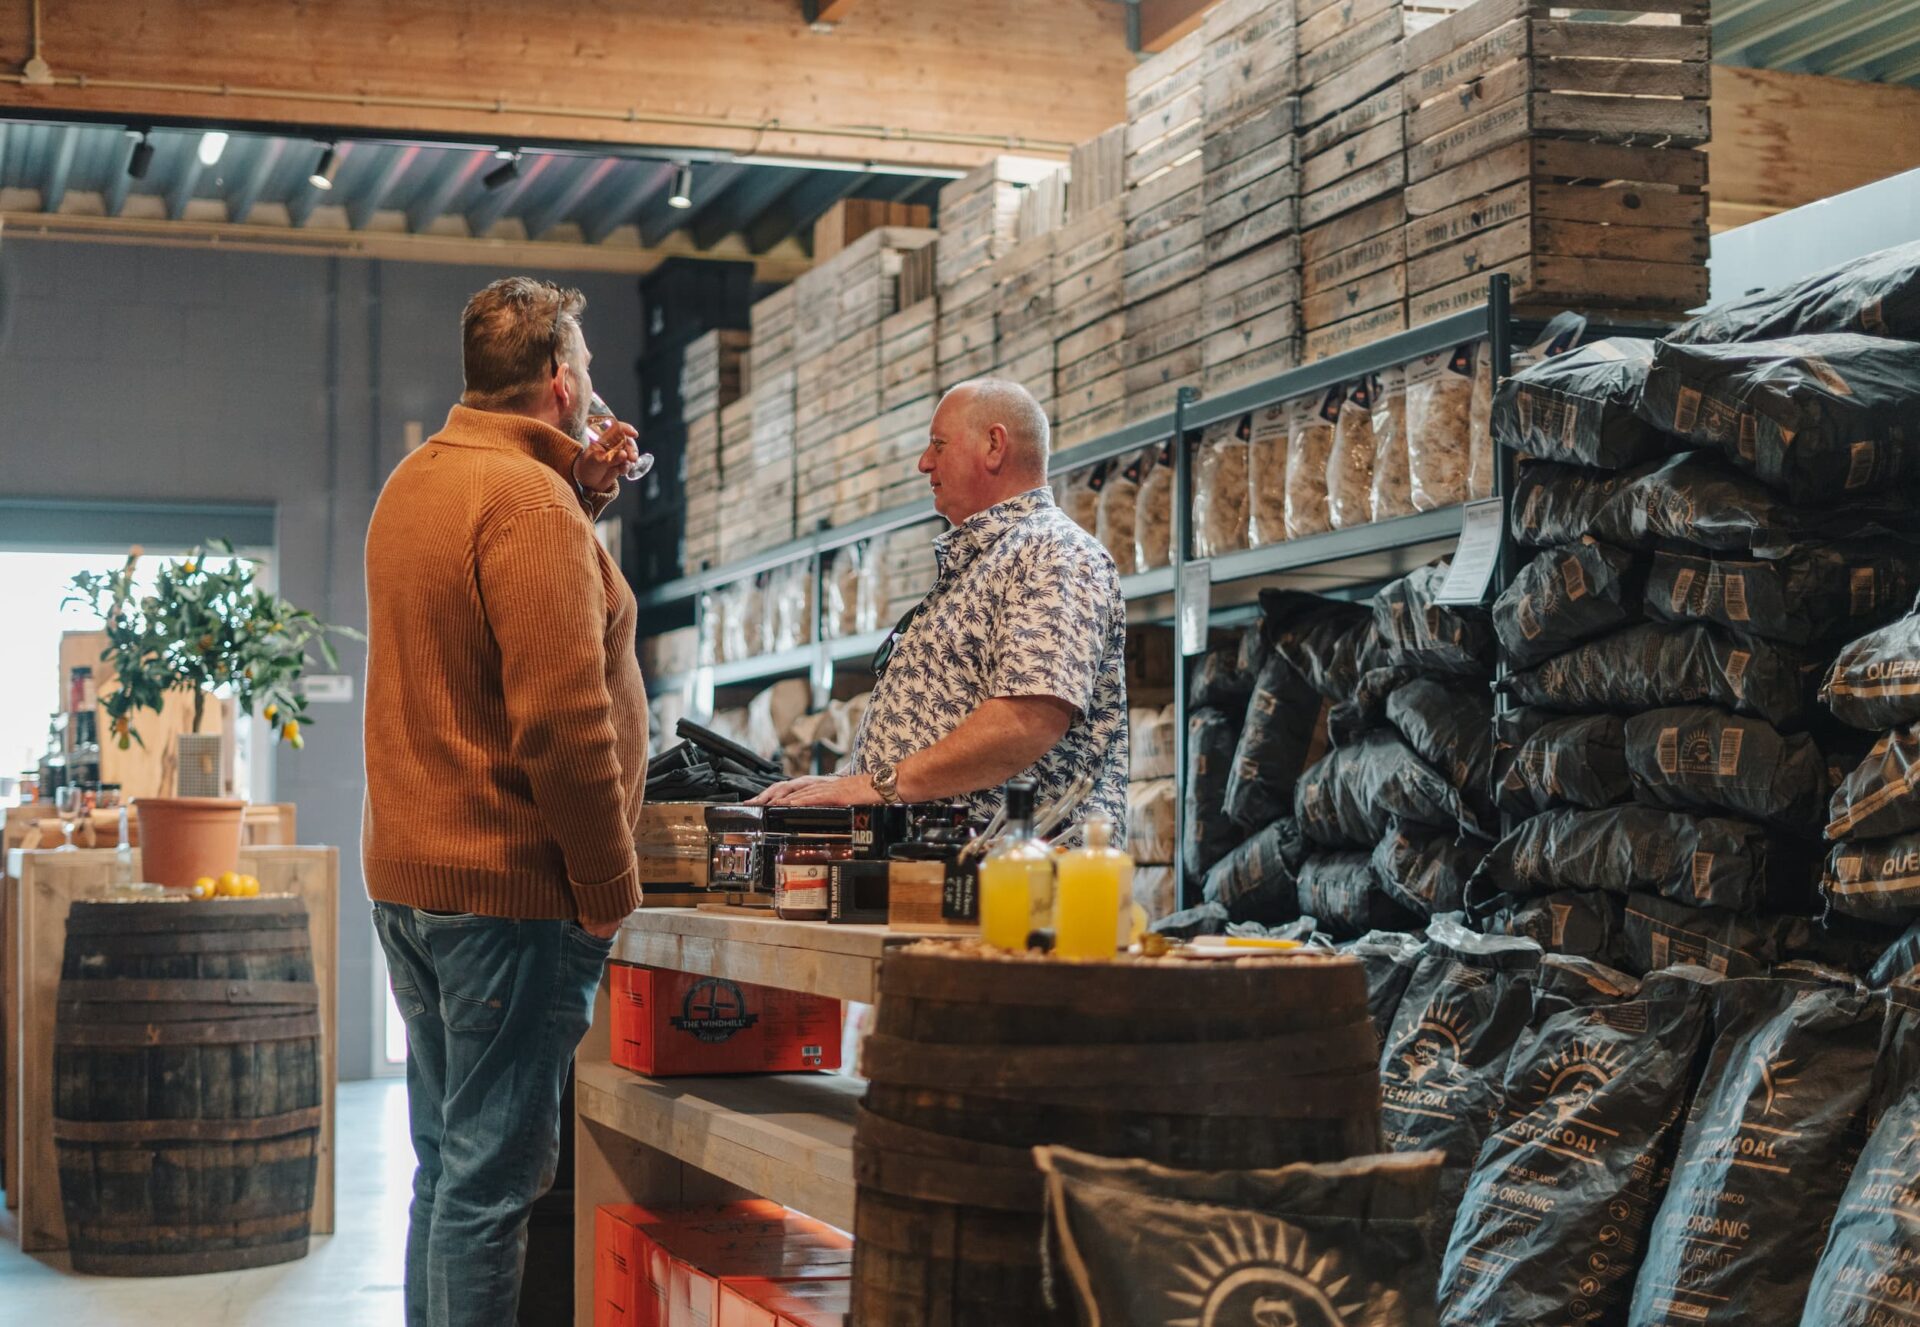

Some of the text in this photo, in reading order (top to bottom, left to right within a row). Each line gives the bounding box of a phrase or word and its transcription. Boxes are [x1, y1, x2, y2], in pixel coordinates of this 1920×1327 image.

[852, 830, 873, 844] TARD
[1882, 852, 1920, 876] QUE
[683, 1018, 743, 1029] THE WINDMILL
[1499, 1186, 1555, 1213] ORGANIC
[1686, 1214, 1750, 1240] ORGANIC
